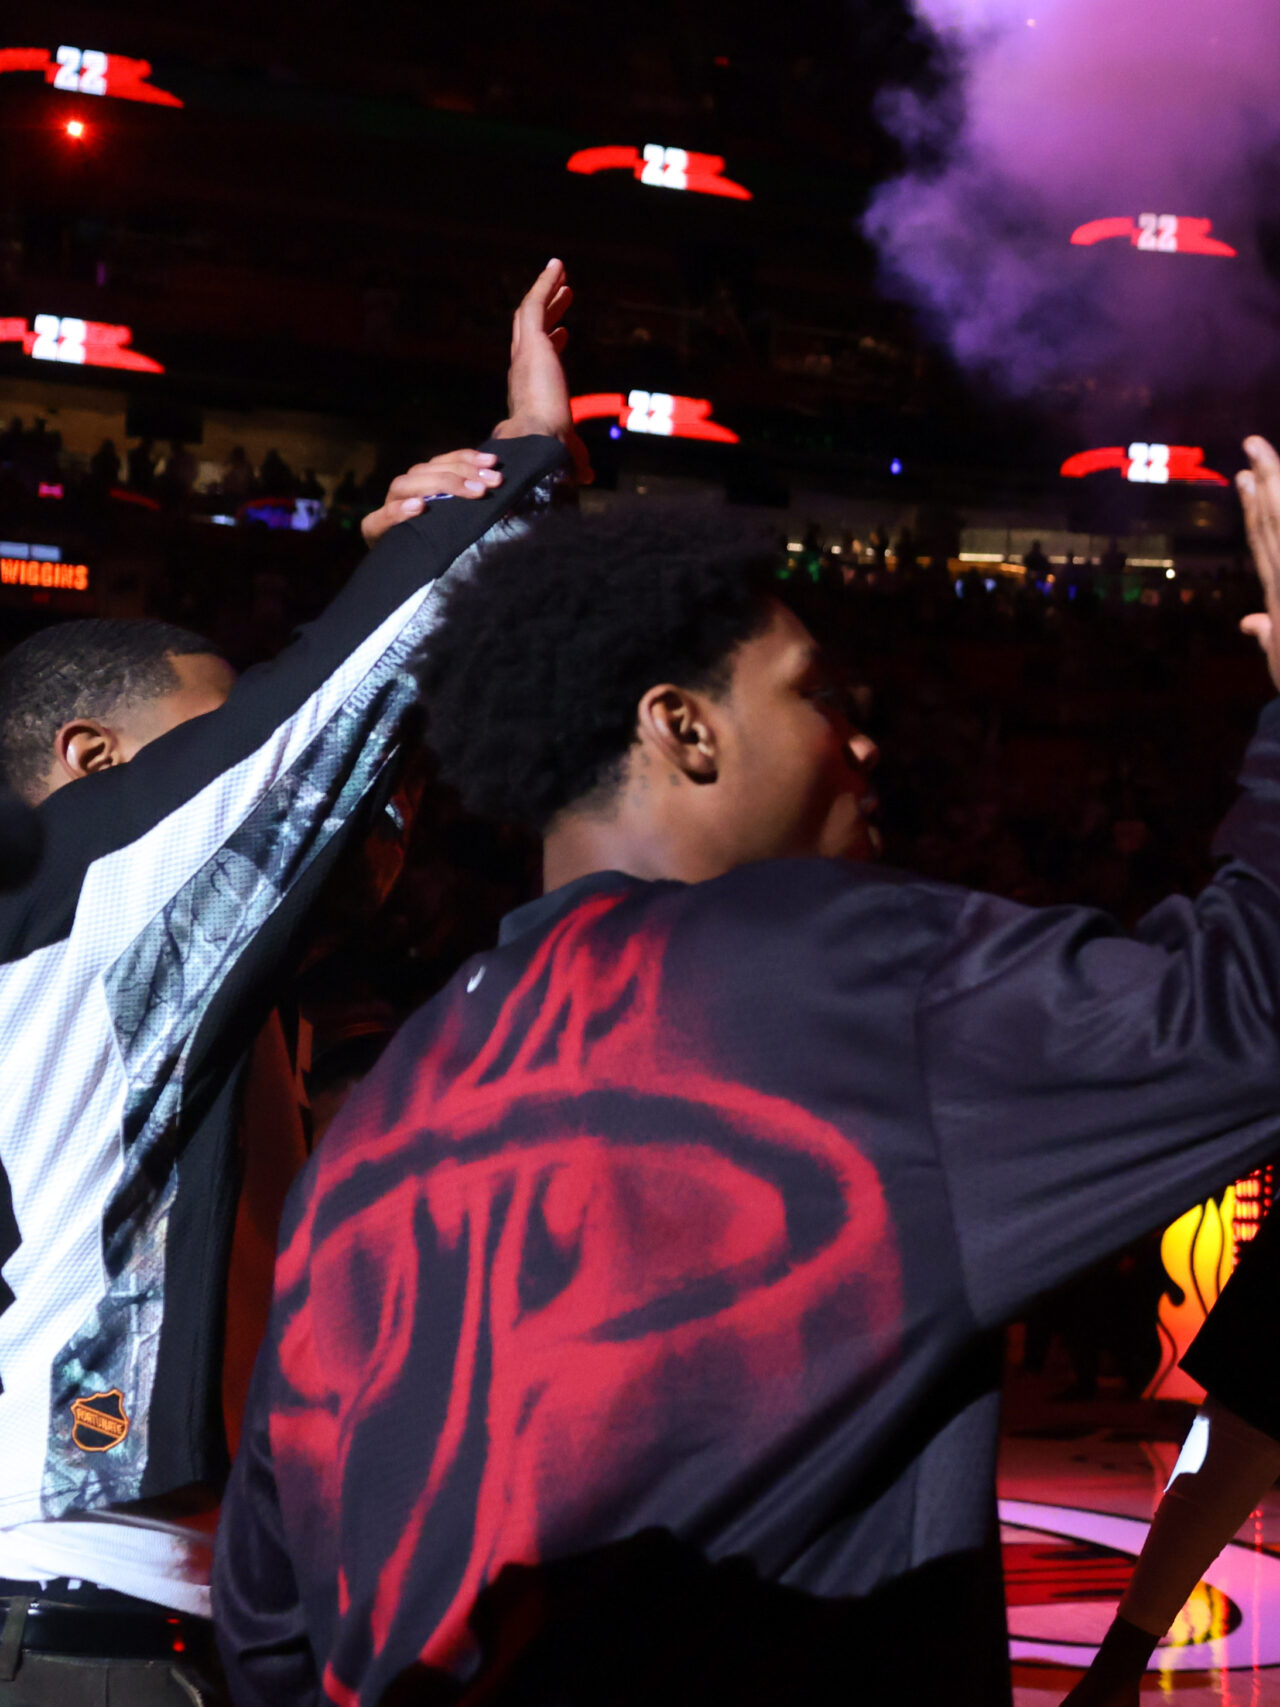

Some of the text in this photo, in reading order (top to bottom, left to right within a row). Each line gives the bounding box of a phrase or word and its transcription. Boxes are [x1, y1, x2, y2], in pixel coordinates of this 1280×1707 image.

[54, 46, 107, 95] 22
[641, 144, 688, 190] 22
[1137, 213, 1178, 253] 22
[32, 314, 85, 364] 22
[627, 390, 674, 436] 22
[1128, 442, 1170, 484] 22
[0, 558, 89, 591] WIGGINS
